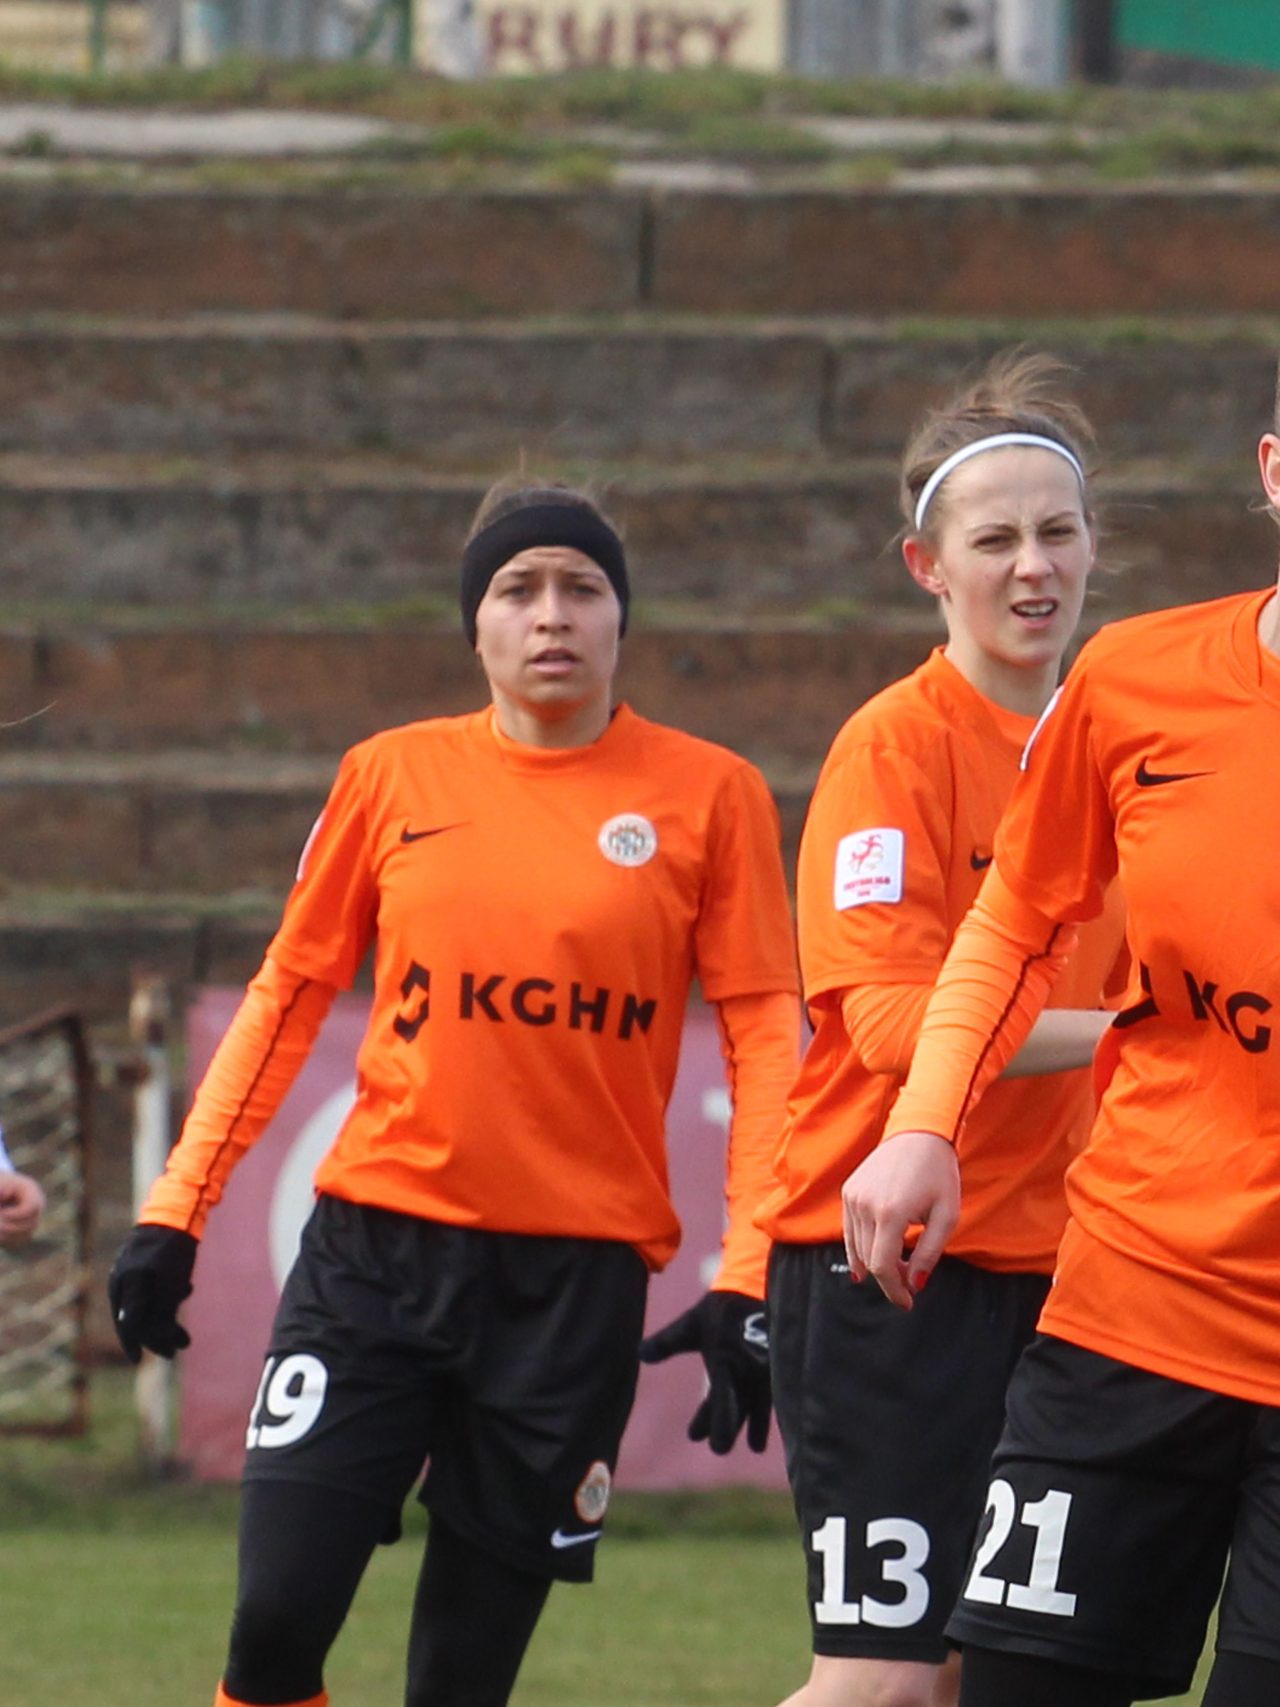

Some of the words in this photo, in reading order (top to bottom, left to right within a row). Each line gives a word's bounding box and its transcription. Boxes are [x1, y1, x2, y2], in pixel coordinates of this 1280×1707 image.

[459, 972, 657, 1041] KGHM
[811, 1516, 931, 1628] 13
[963, 1478, 1077, 1617] 21
